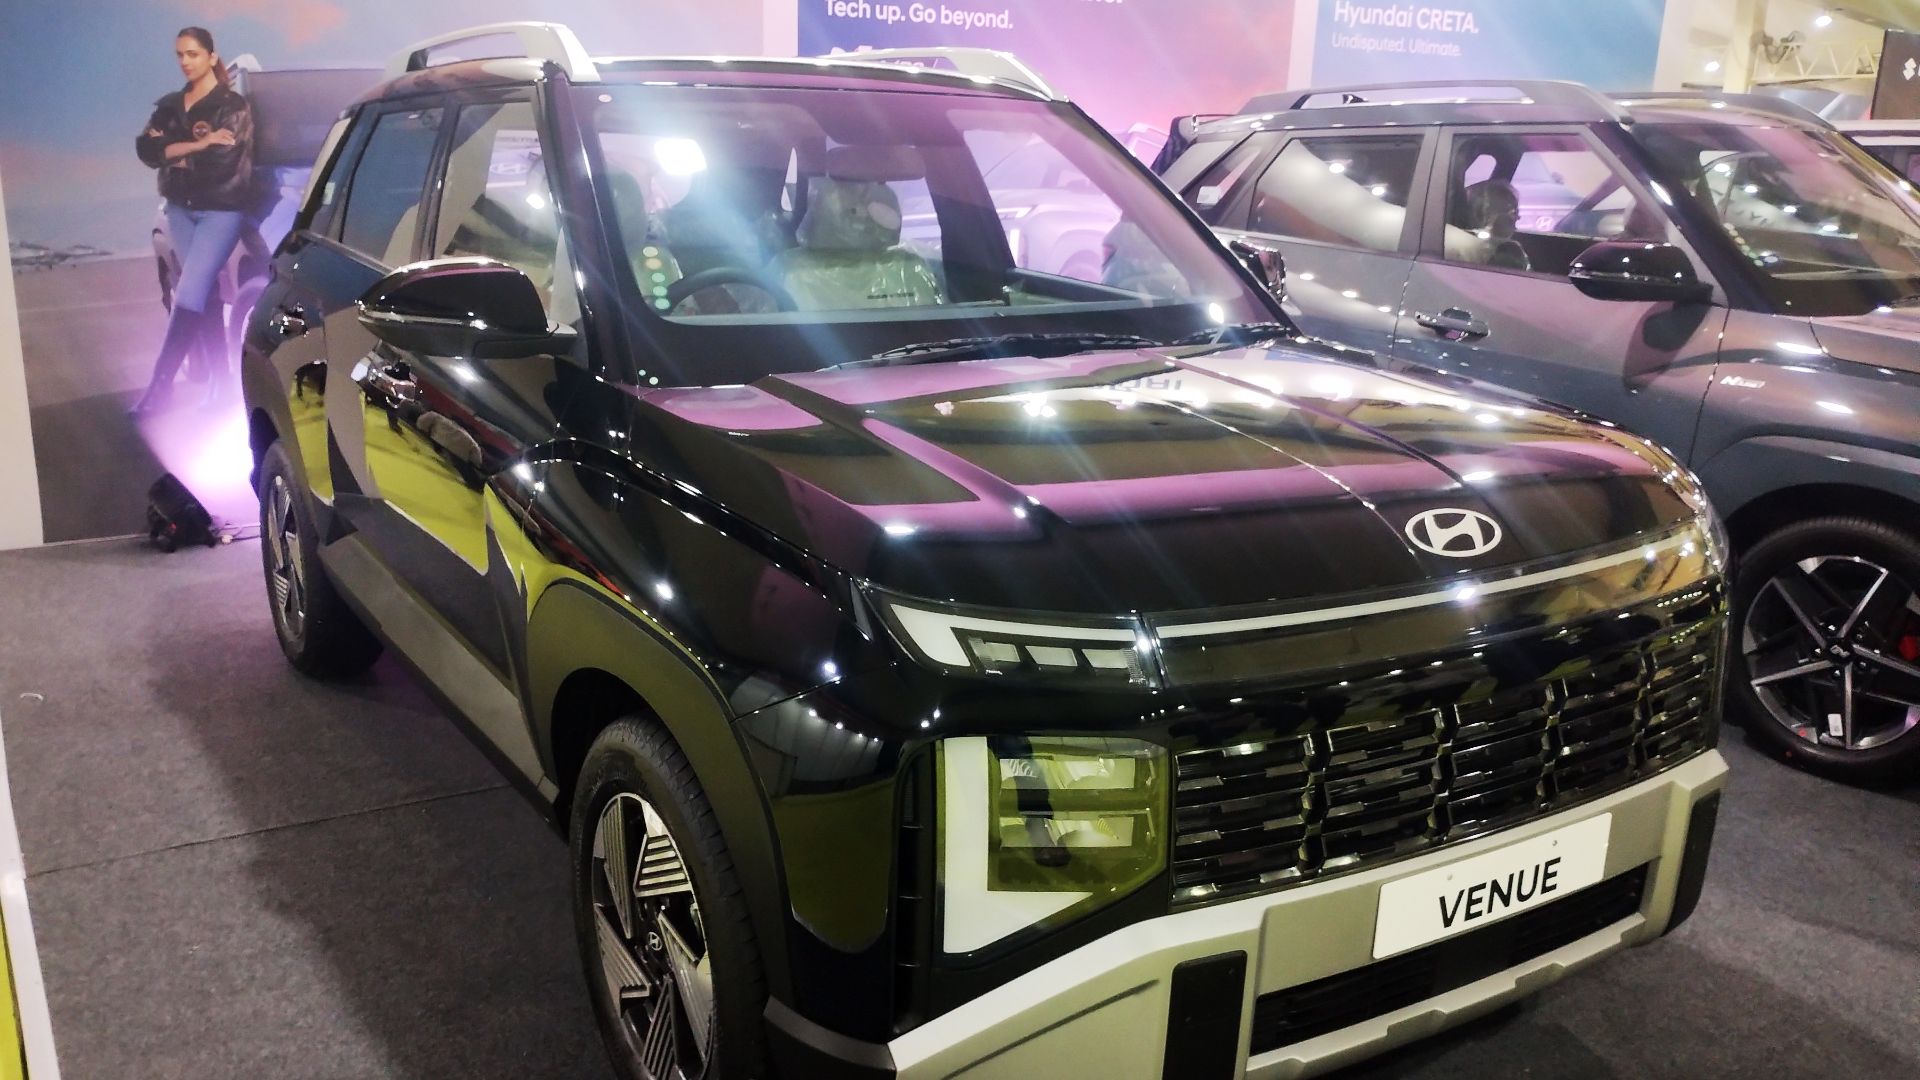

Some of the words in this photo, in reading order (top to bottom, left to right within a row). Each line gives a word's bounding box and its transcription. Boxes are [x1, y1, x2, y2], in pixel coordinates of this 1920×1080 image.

[825, 0, 871, 19] Tech
[875, 4, 906, 25] up.
[909, 3, 937, 24] Go
[940, 5, 1014, 30] beyond.
[1333, 0, 1414, 28] Hyundai
[1416, 8, 1479, 34] CRETA.
[1331, 32, 1407, 53] Undisputed.
[1409, 39, 1462, 57] Ultimate.
[1438, 856, 1562, 929] VENUE
